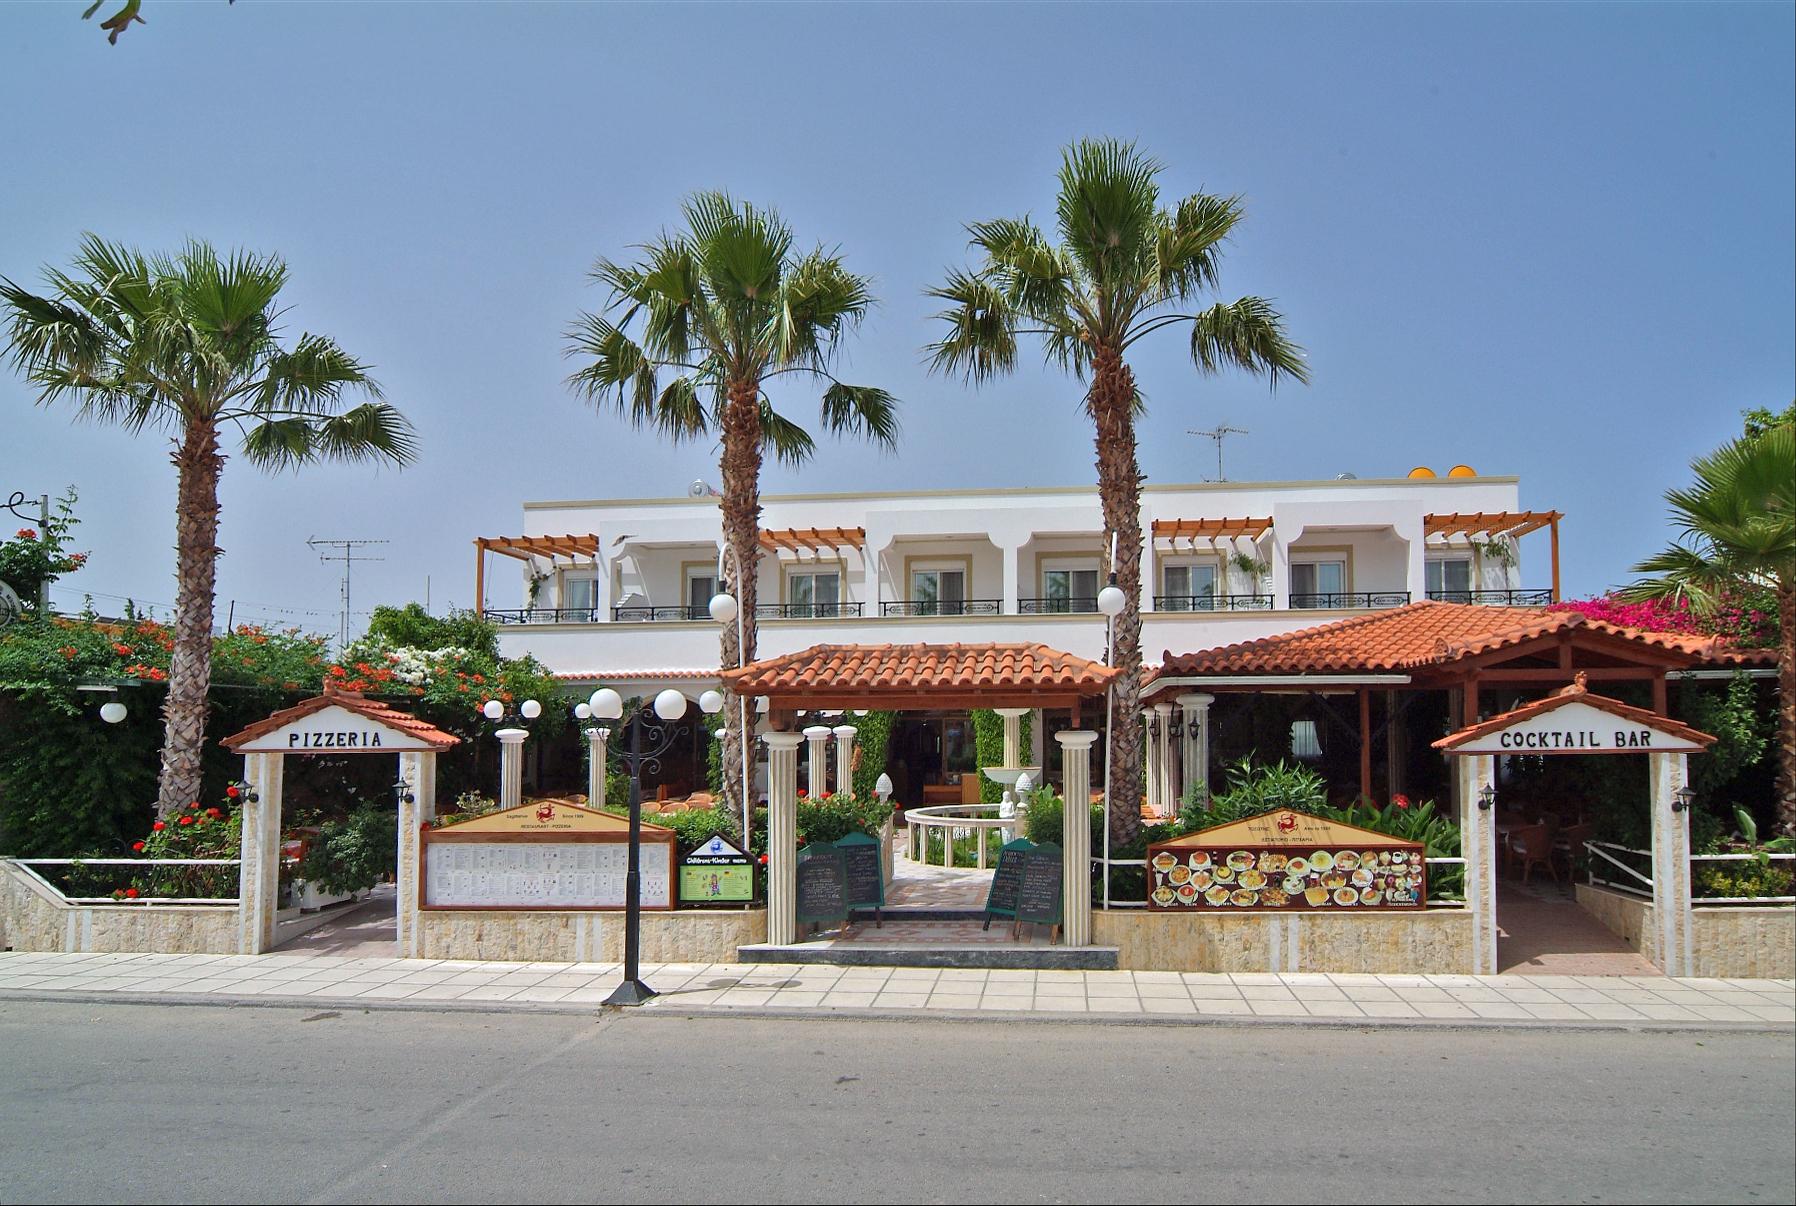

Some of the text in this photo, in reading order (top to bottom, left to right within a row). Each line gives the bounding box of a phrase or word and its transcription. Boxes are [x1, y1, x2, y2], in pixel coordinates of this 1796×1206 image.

[289, 732, 381, 748] PIZZERIA
[1501, 731, 1651, 748] COCKTAIL BAR
